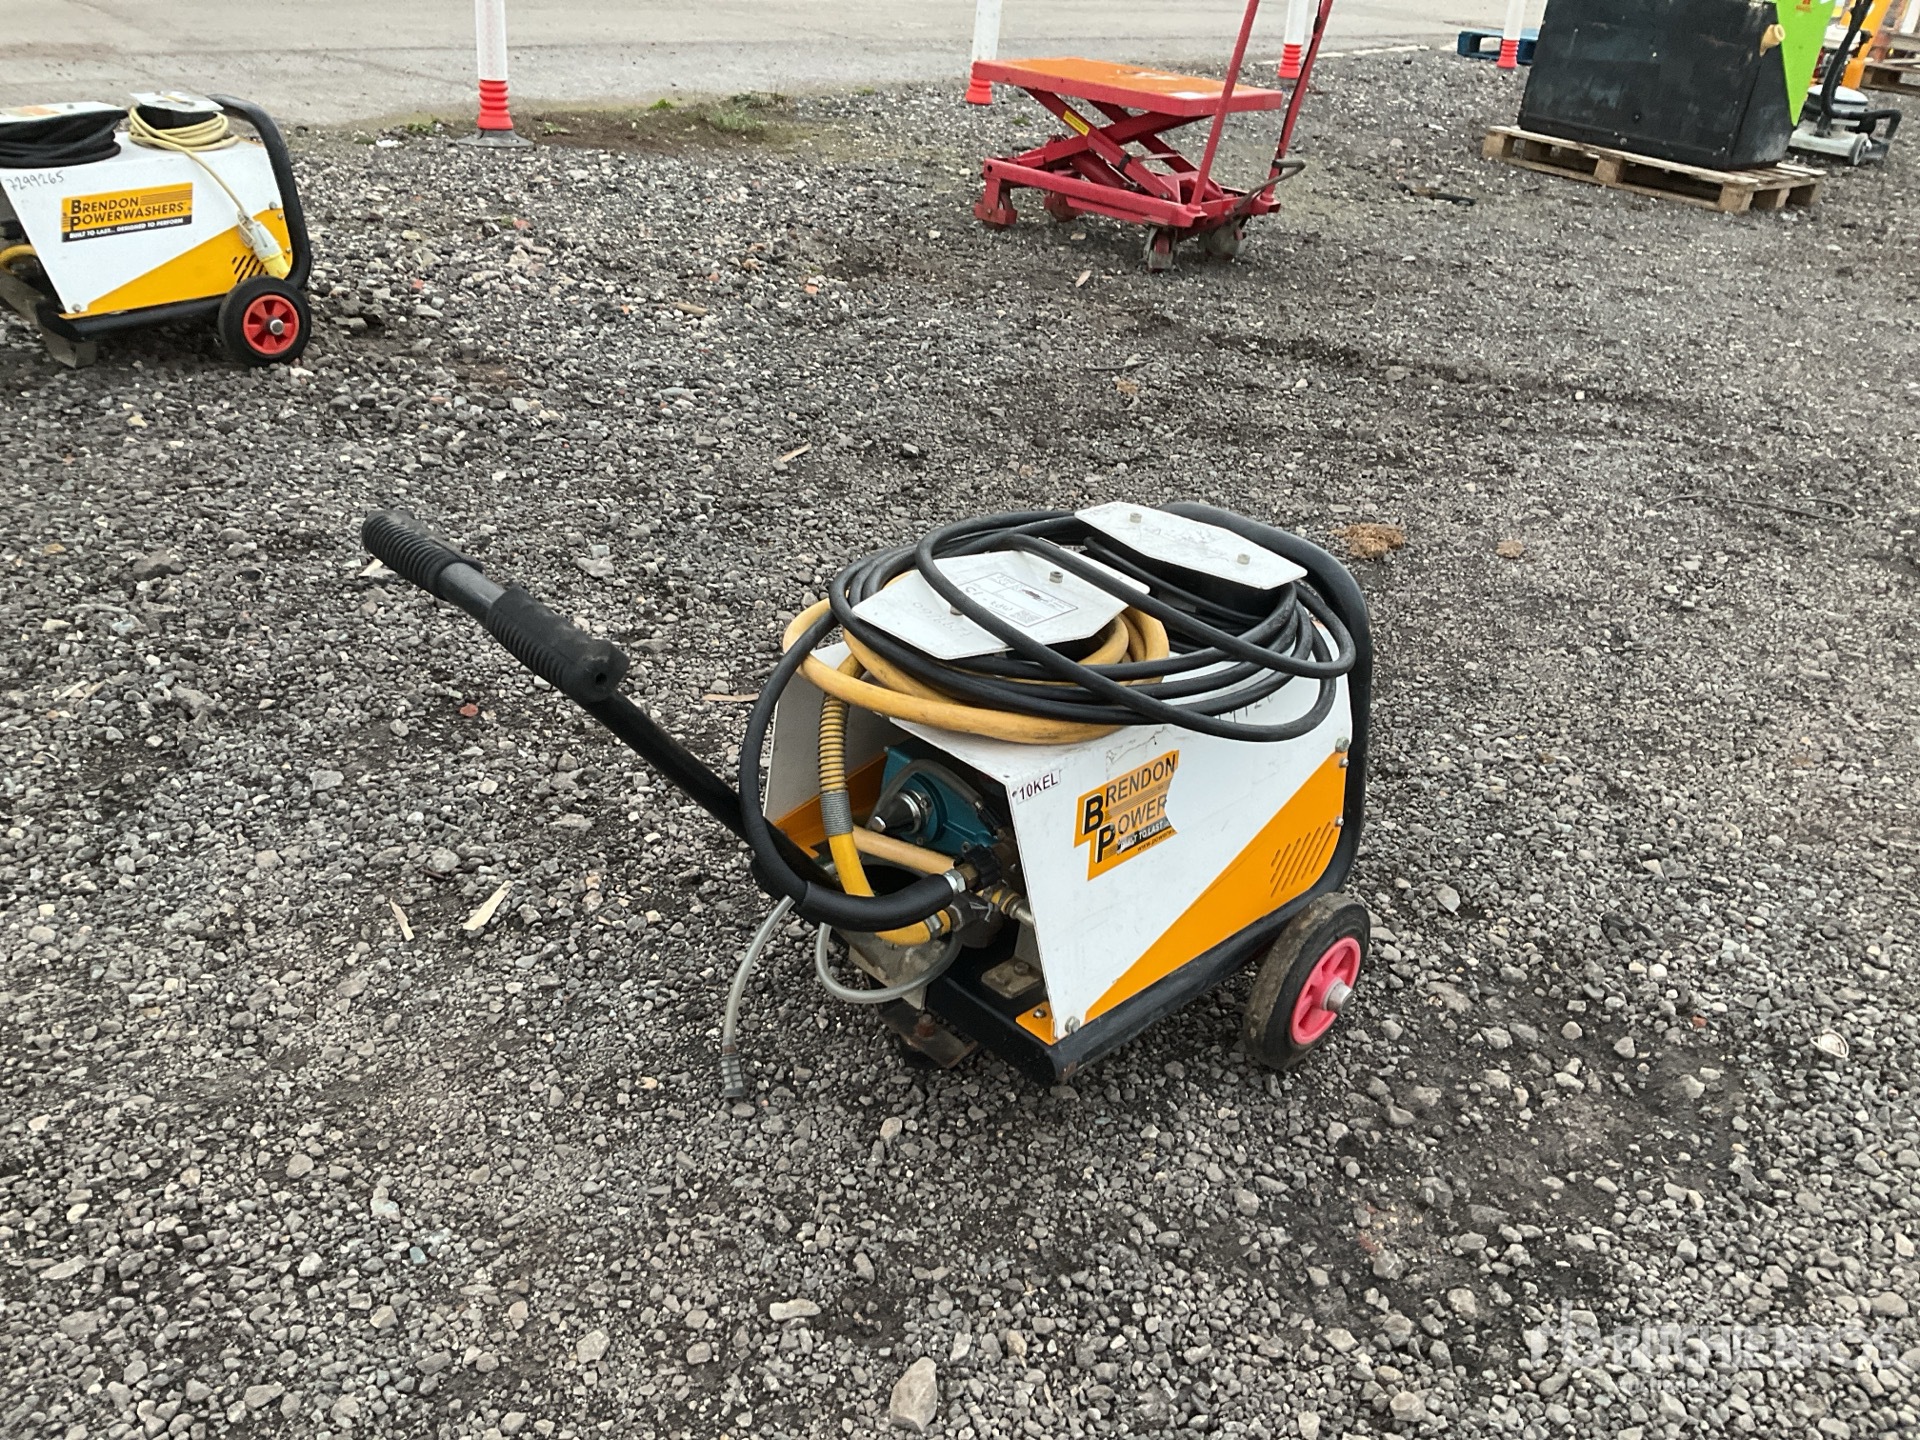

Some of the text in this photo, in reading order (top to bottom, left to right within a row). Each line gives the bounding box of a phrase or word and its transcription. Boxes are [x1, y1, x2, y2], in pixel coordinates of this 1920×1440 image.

[70, 202, 184, 231] POWERWASHERS
[71, 196, 139, 215] BRENDON
[1019, 772, 1058, 800] 10KEL
[1083, 753, 1176, 835] BRENDON
